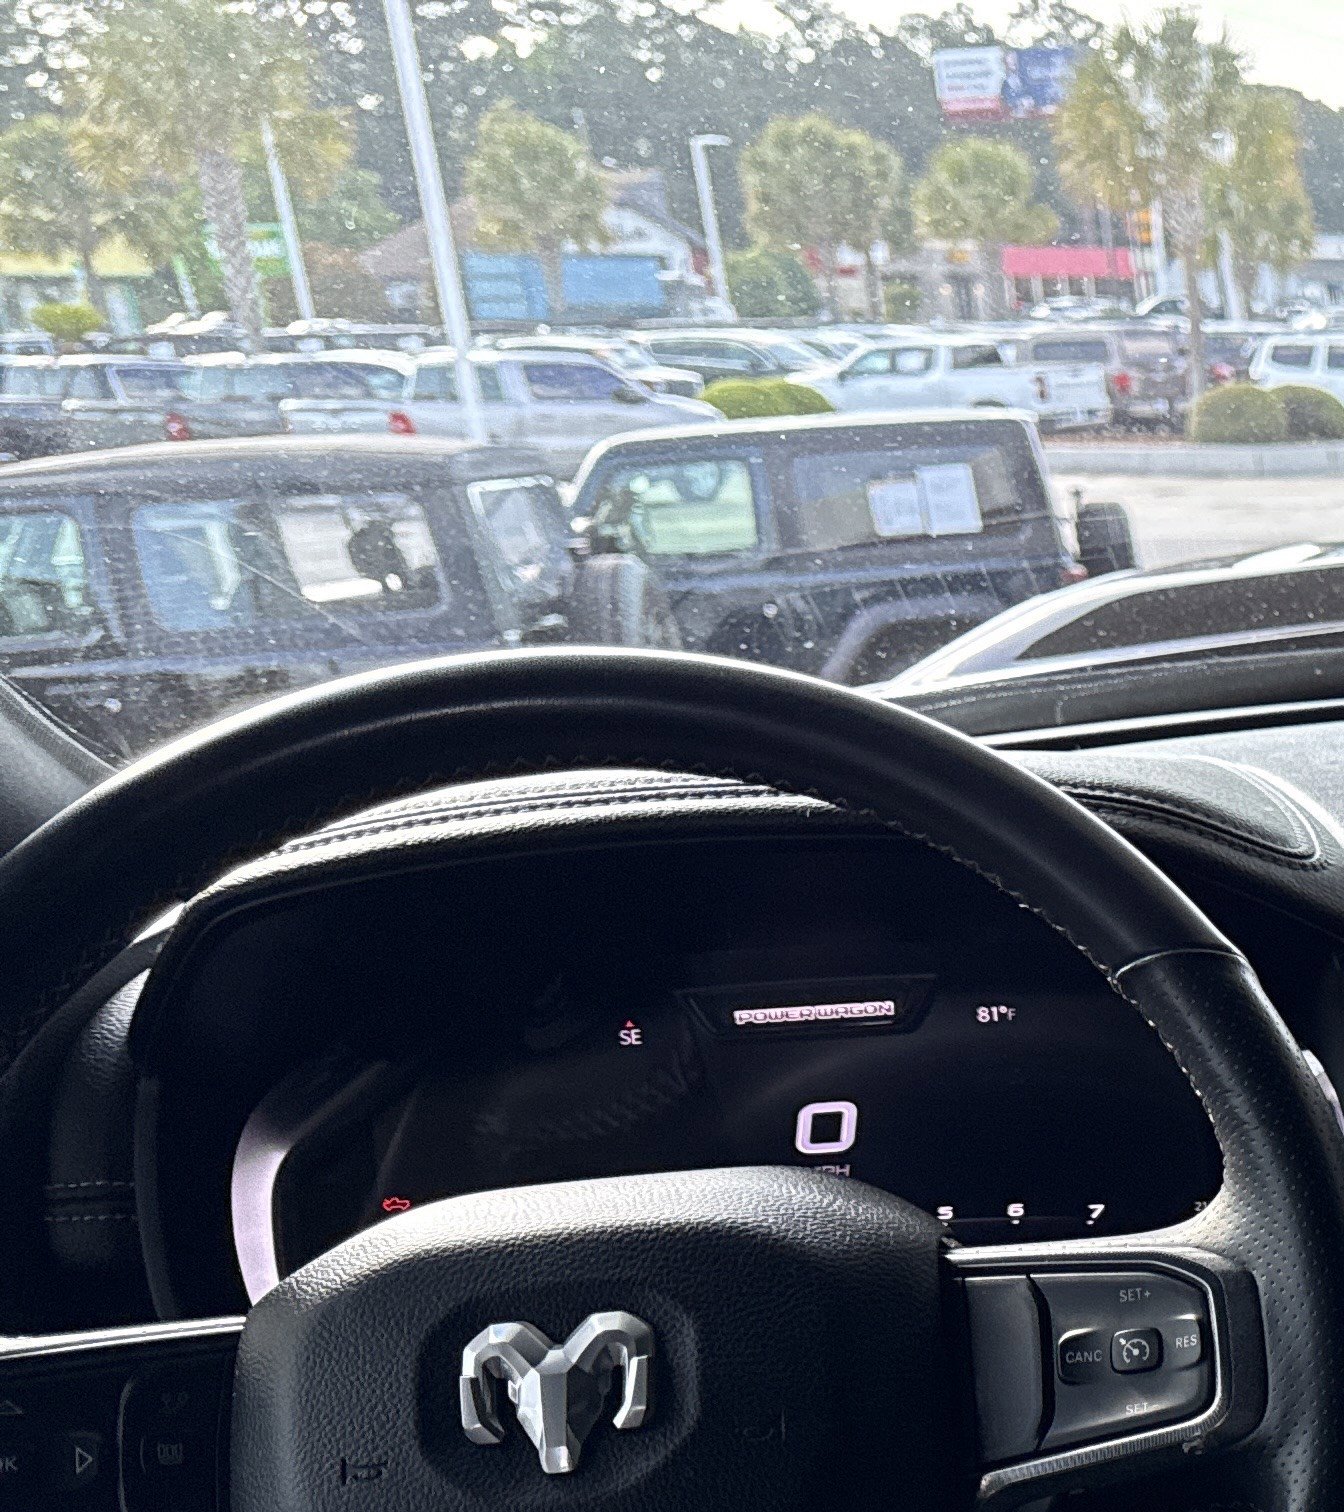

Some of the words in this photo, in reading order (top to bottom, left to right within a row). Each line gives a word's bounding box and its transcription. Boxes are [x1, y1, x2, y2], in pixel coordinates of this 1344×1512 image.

[734, 1004, 815, 1025] POWER
[815, 1000, 895, 1021] WAGON
[617, 1028, 644, 1046] SE
[796, 1100, 859, 1155] 0
[937, 1205, 954, 1220] 5
[1007, 1203, 1024, 1217] 6
[1089, 1203, 1105, 1219] 7
[1175, 1334, 1198, 1349] RES
[1065, 1350, 1103, 1364] CANC
[0, 1456, 18, 1472] K
